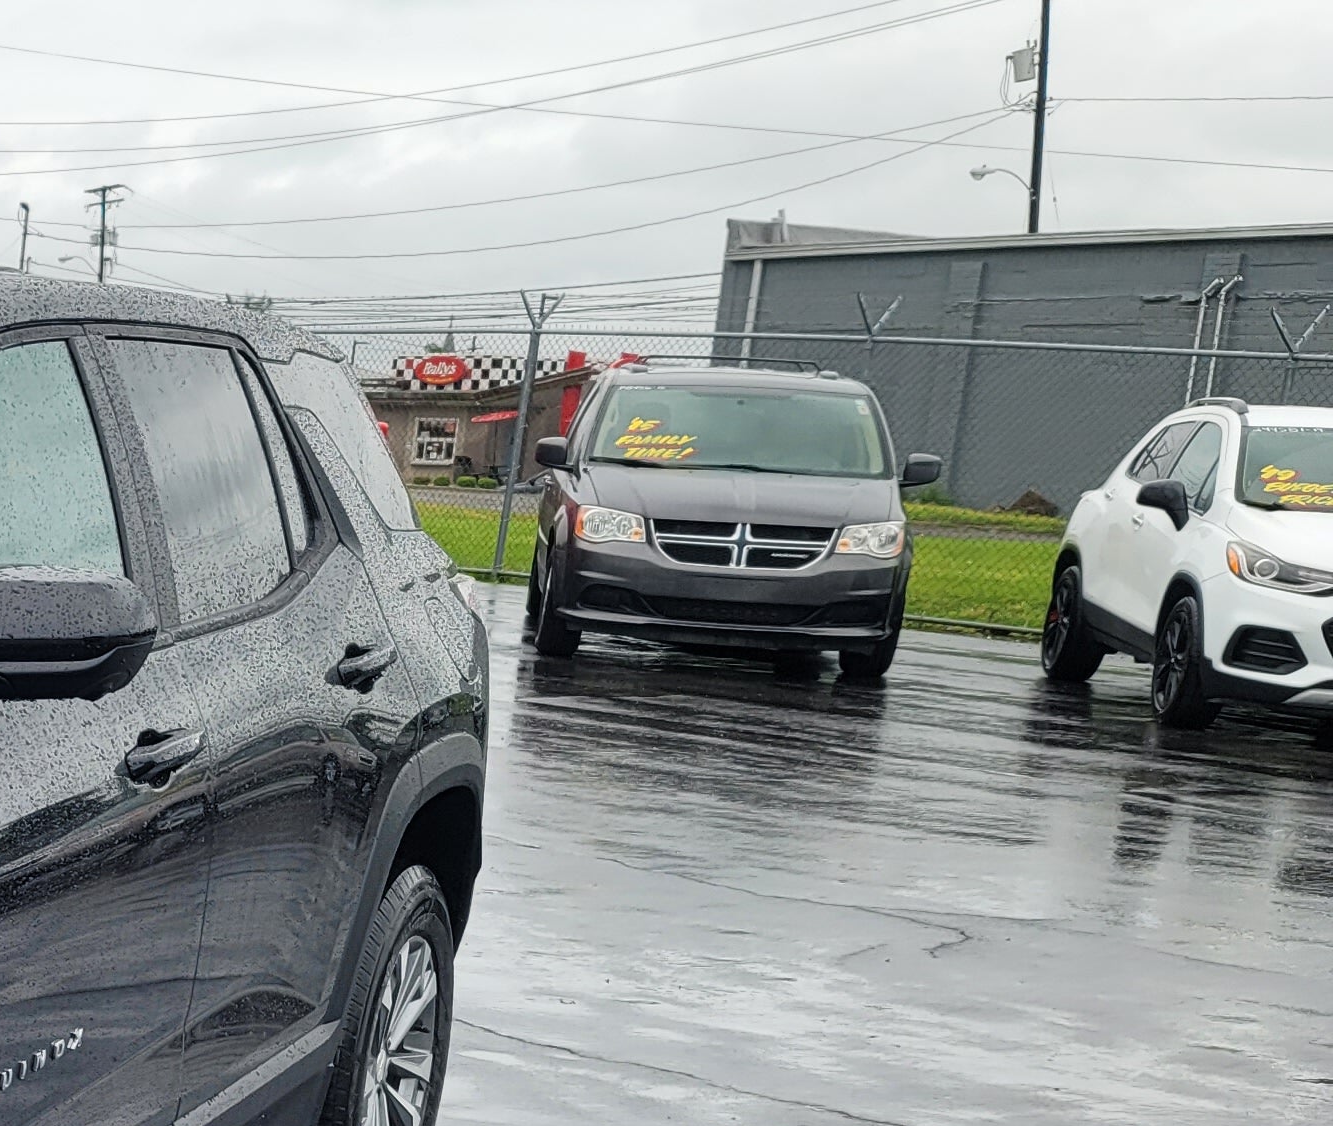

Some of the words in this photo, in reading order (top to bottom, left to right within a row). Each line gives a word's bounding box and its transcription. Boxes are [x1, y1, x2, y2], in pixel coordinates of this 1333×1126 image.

[615, 434, 698, 446] FAMILY
[623, 447, 694, 459] TIME!
[1263, 481, 1333, 494] BUDGE
